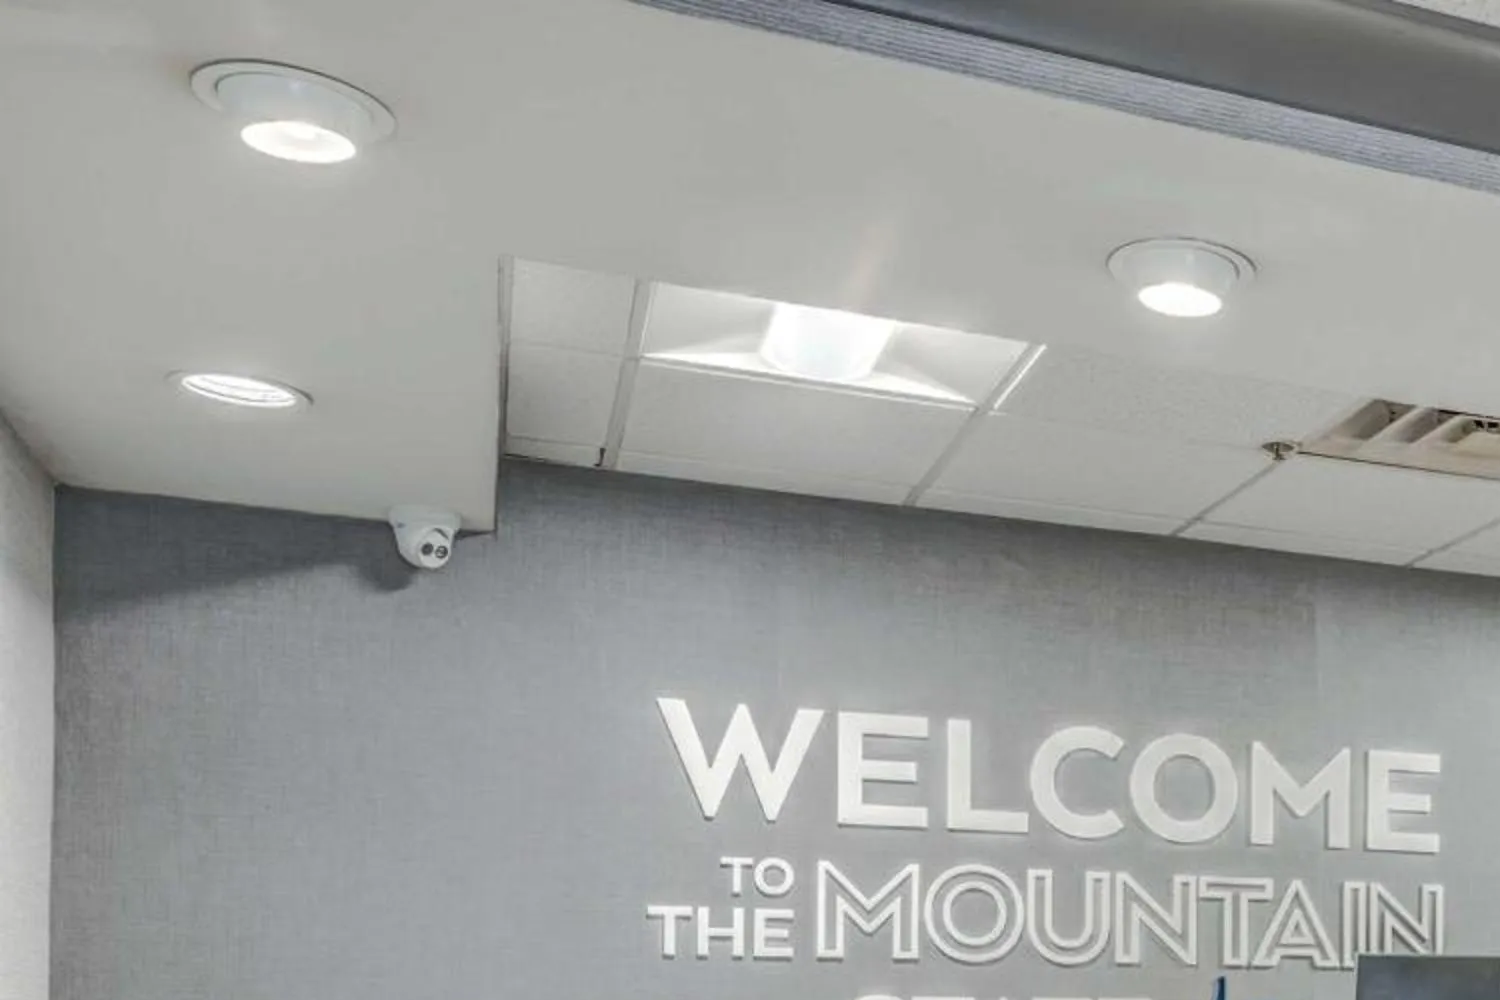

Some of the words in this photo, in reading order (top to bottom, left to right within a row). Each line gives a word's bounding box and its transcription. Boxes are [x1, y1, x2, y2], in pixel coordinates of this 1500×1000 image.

[656, 697, 1441, 853] WELCOME
[647, 904, 793, 958] THE
[815, 858, 1442, 969] MOUNTAIN
[720, 856, 793, 895] TO
